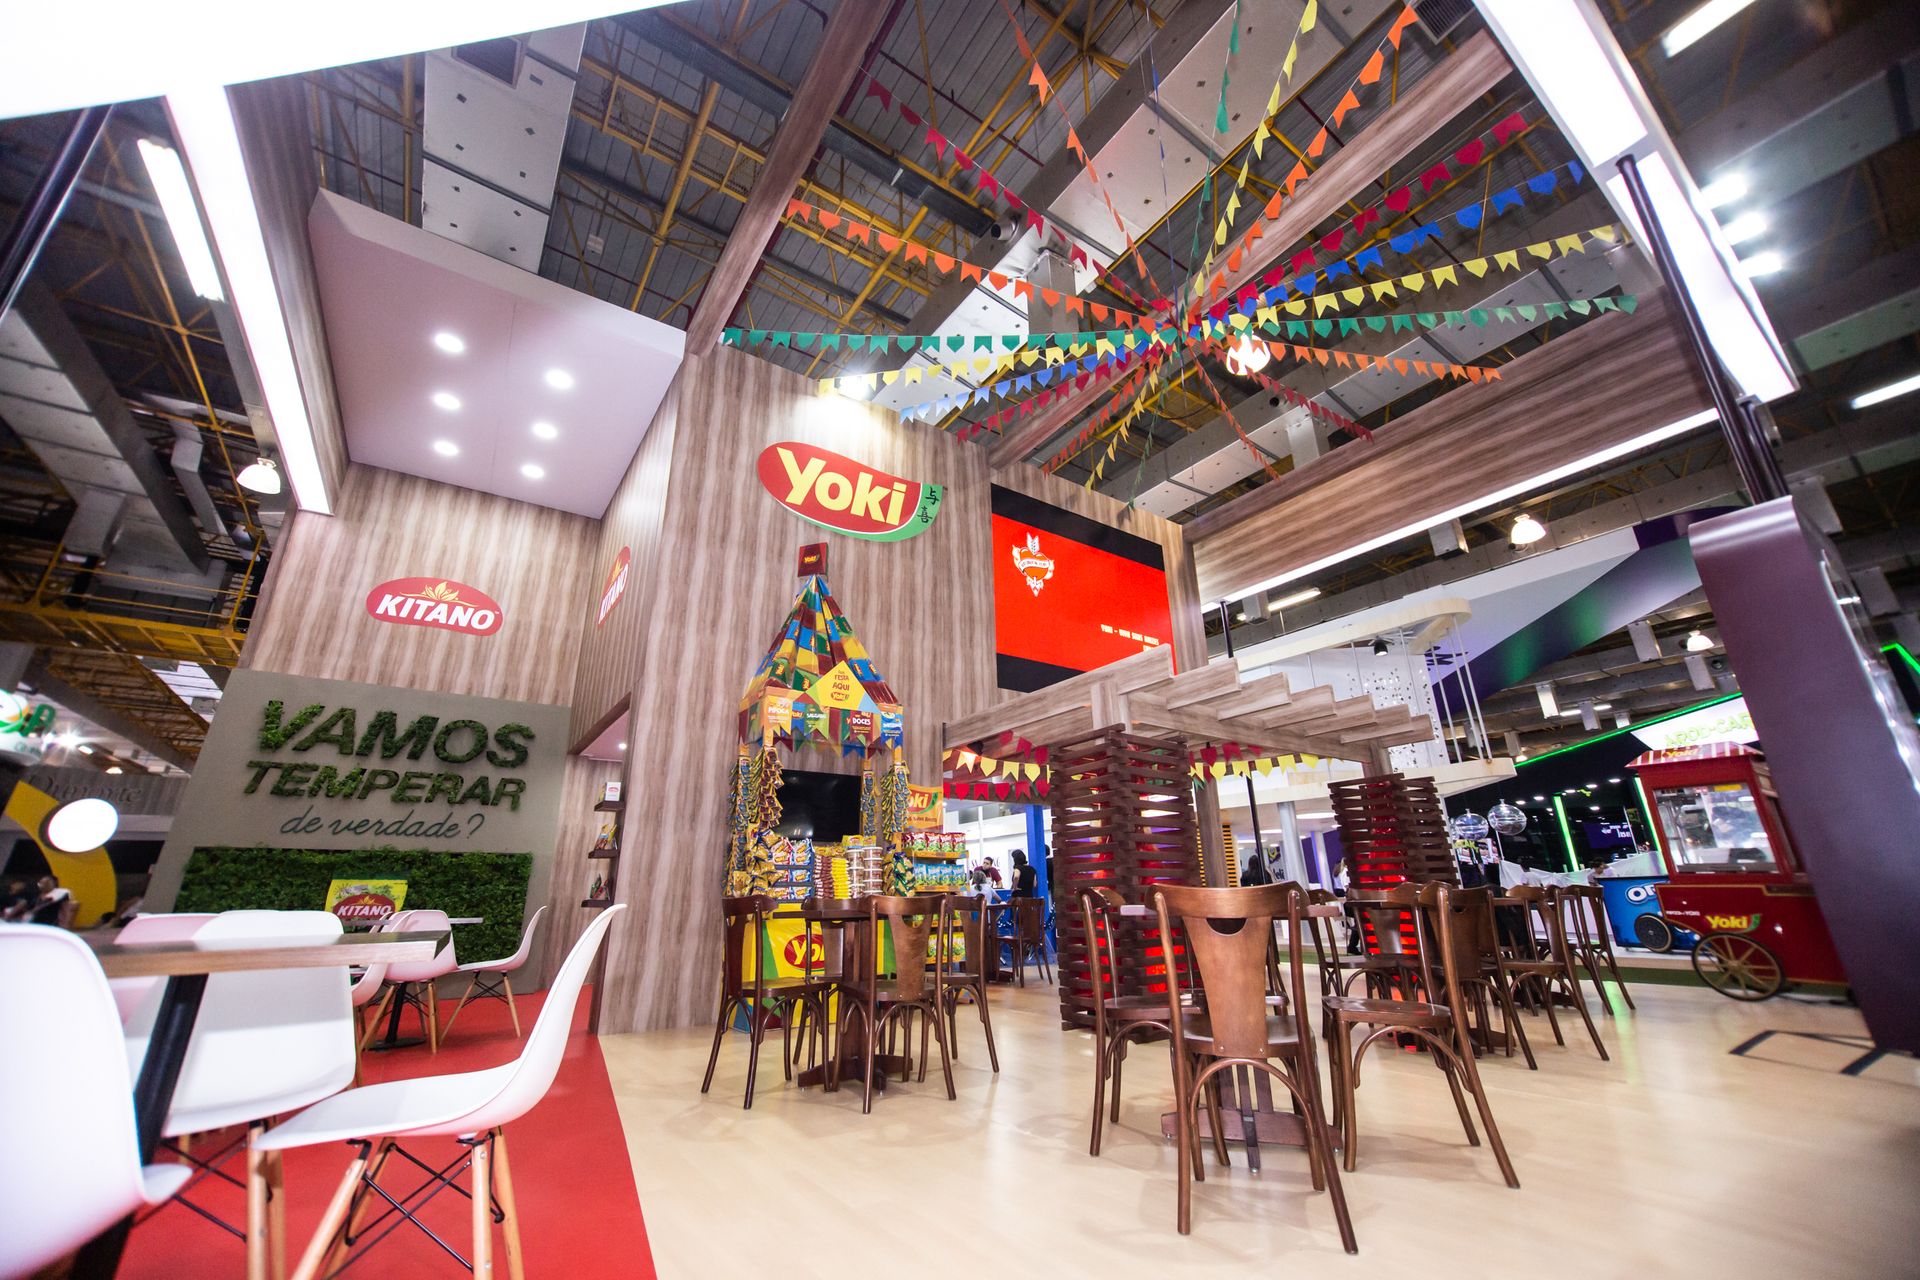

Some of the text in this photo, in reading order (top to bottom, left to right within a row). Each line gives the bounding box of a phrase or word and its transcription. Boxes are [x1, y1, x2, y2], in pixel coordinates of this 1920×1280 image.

[776, 446, 908, 526] Yoki
[376, 594, 495, 630] KITANO
[832, 682, 850, 691] AQUI
[259, 700, 536, 768] VAMOS
[243, 760, 527, 811] TEMPERAR
[280, 805, 486, 840] de verdade?
[337, 905, 392, 916] KITANO
[1705, 915, 1748, 929] Yoki
